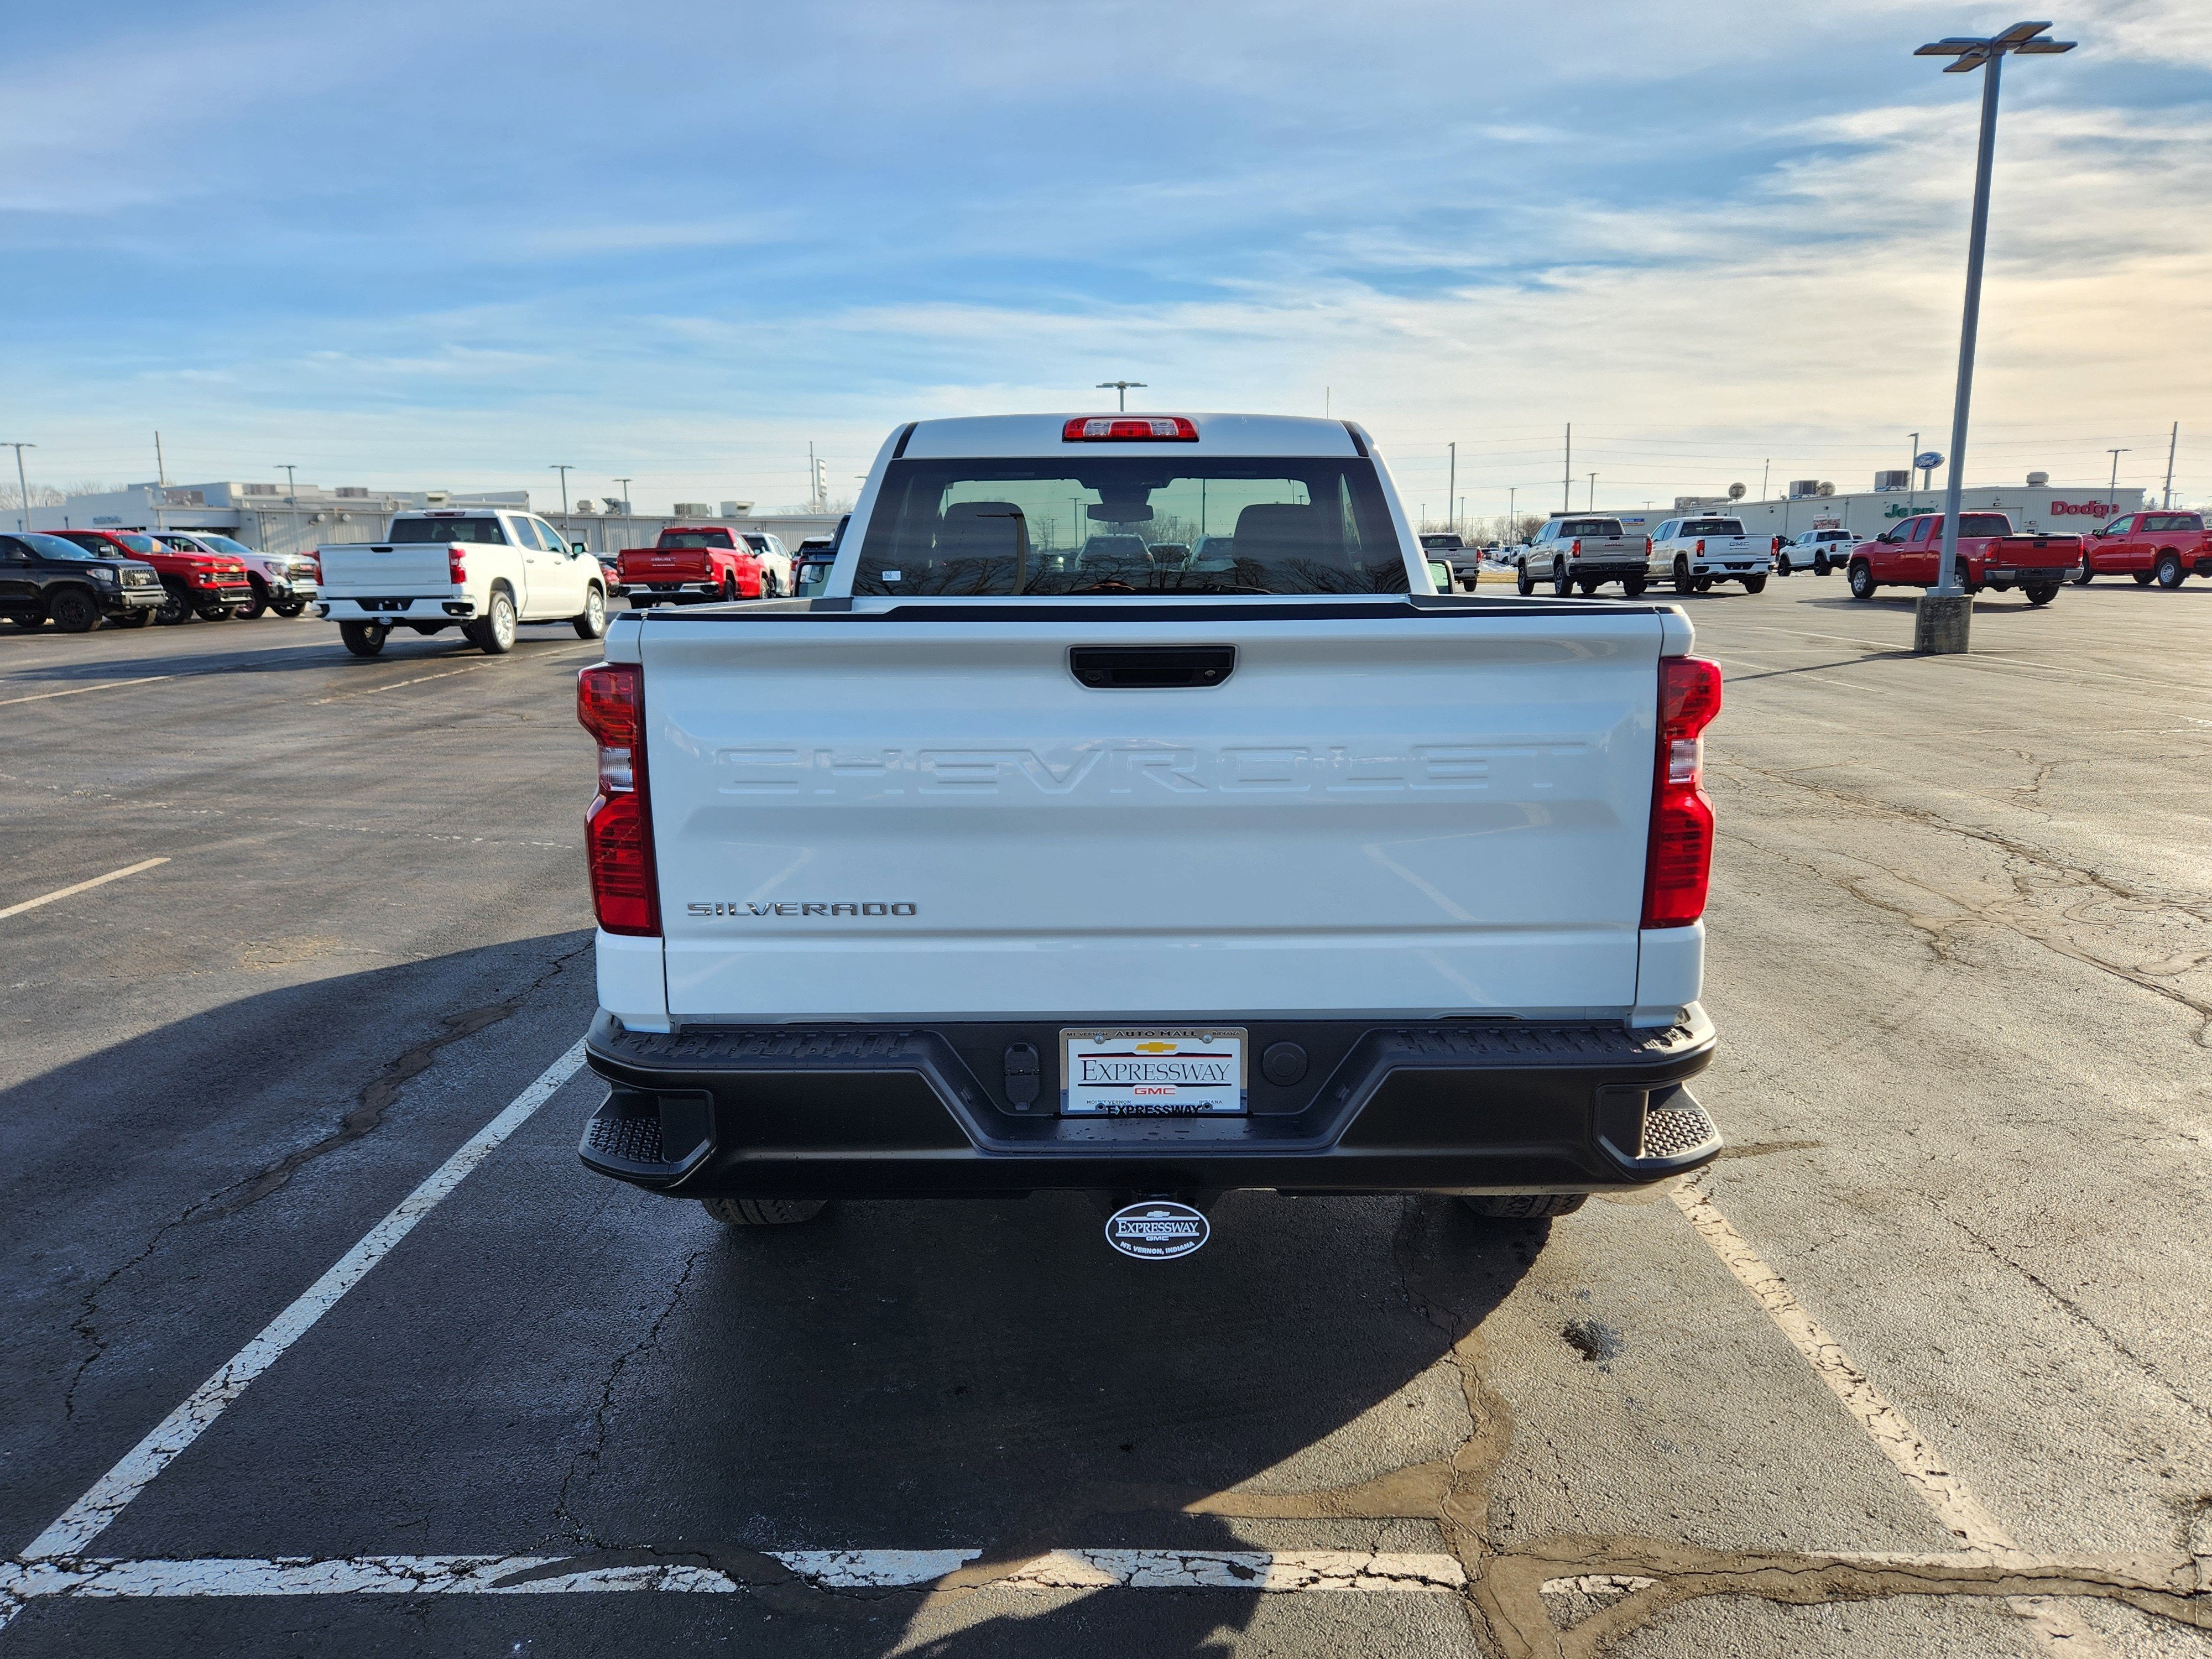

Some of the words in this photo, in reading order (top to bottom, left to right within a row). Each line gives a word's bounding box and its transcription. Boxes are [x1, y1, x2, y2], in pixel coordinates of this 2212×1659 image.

[1918, 455, 1936, 466] Ford
[2051, 500, 2120, 519] Dodge
[713, 742, 1588, 795] CHEVROLET
[687, 901, 918, 916] SILVERADO
[1081, 1060, 1230, 1082] EXPRESSWAY
[1107, 1104, 1203, 1115] EXPRESSWAY
[1117, 1220, 1198, 1233] EXPRESSWAY
[1120, 1241, 1131, 1250] MT.
[1133, 1245, 1165, 1255] VERNON,
[1165, 1241, 1195, 1254] INDIANA
